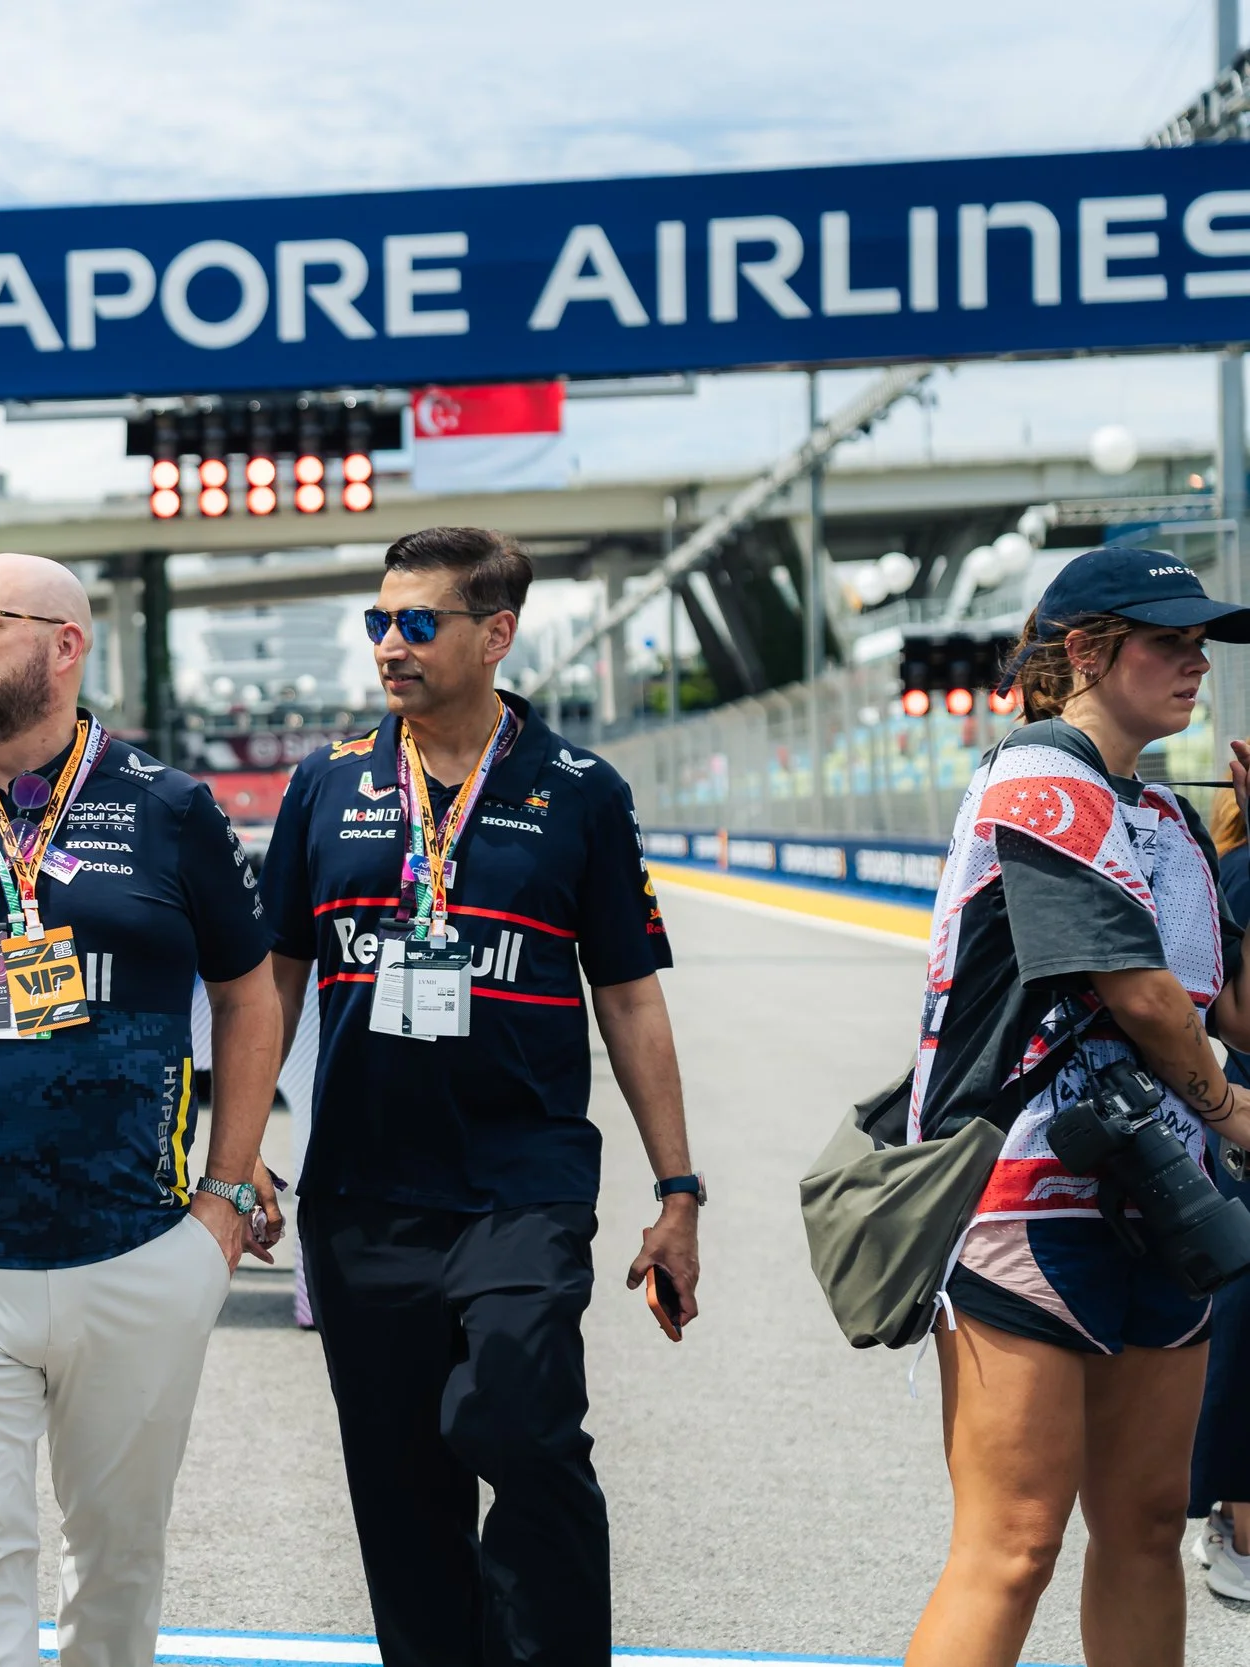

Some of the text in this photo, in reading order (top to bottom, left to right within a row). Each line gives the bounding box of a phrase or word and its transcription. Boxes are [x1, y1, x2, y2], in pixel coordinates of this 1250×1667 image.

[528, 190, 1250, 331] AIRLINES
[1149, 566, 1184, 577] PARC
[119, 766, 155, 782] CASTORE
[551, 759, 585, 778] CASTORE
[69, 802, 137, 813] ORACLE
[343, 808, 385, 822] Mobil
[68, 812, 105, 822] Red Bull
[66, 823, 135, 833] RACING
[481, 816, 543, 834] HONDA
[340, 829, 397, 839] ORACLE
[65, 841, 133, 853] HONDA
[81, 860, 134, 875] Gate.io
[334, 917, 378, 965] Re
[14, 964, 76, 996] VIP
[85, 952, 114, 1002] ll
[154, 1066, 177, 1207] HYPEBEAST
